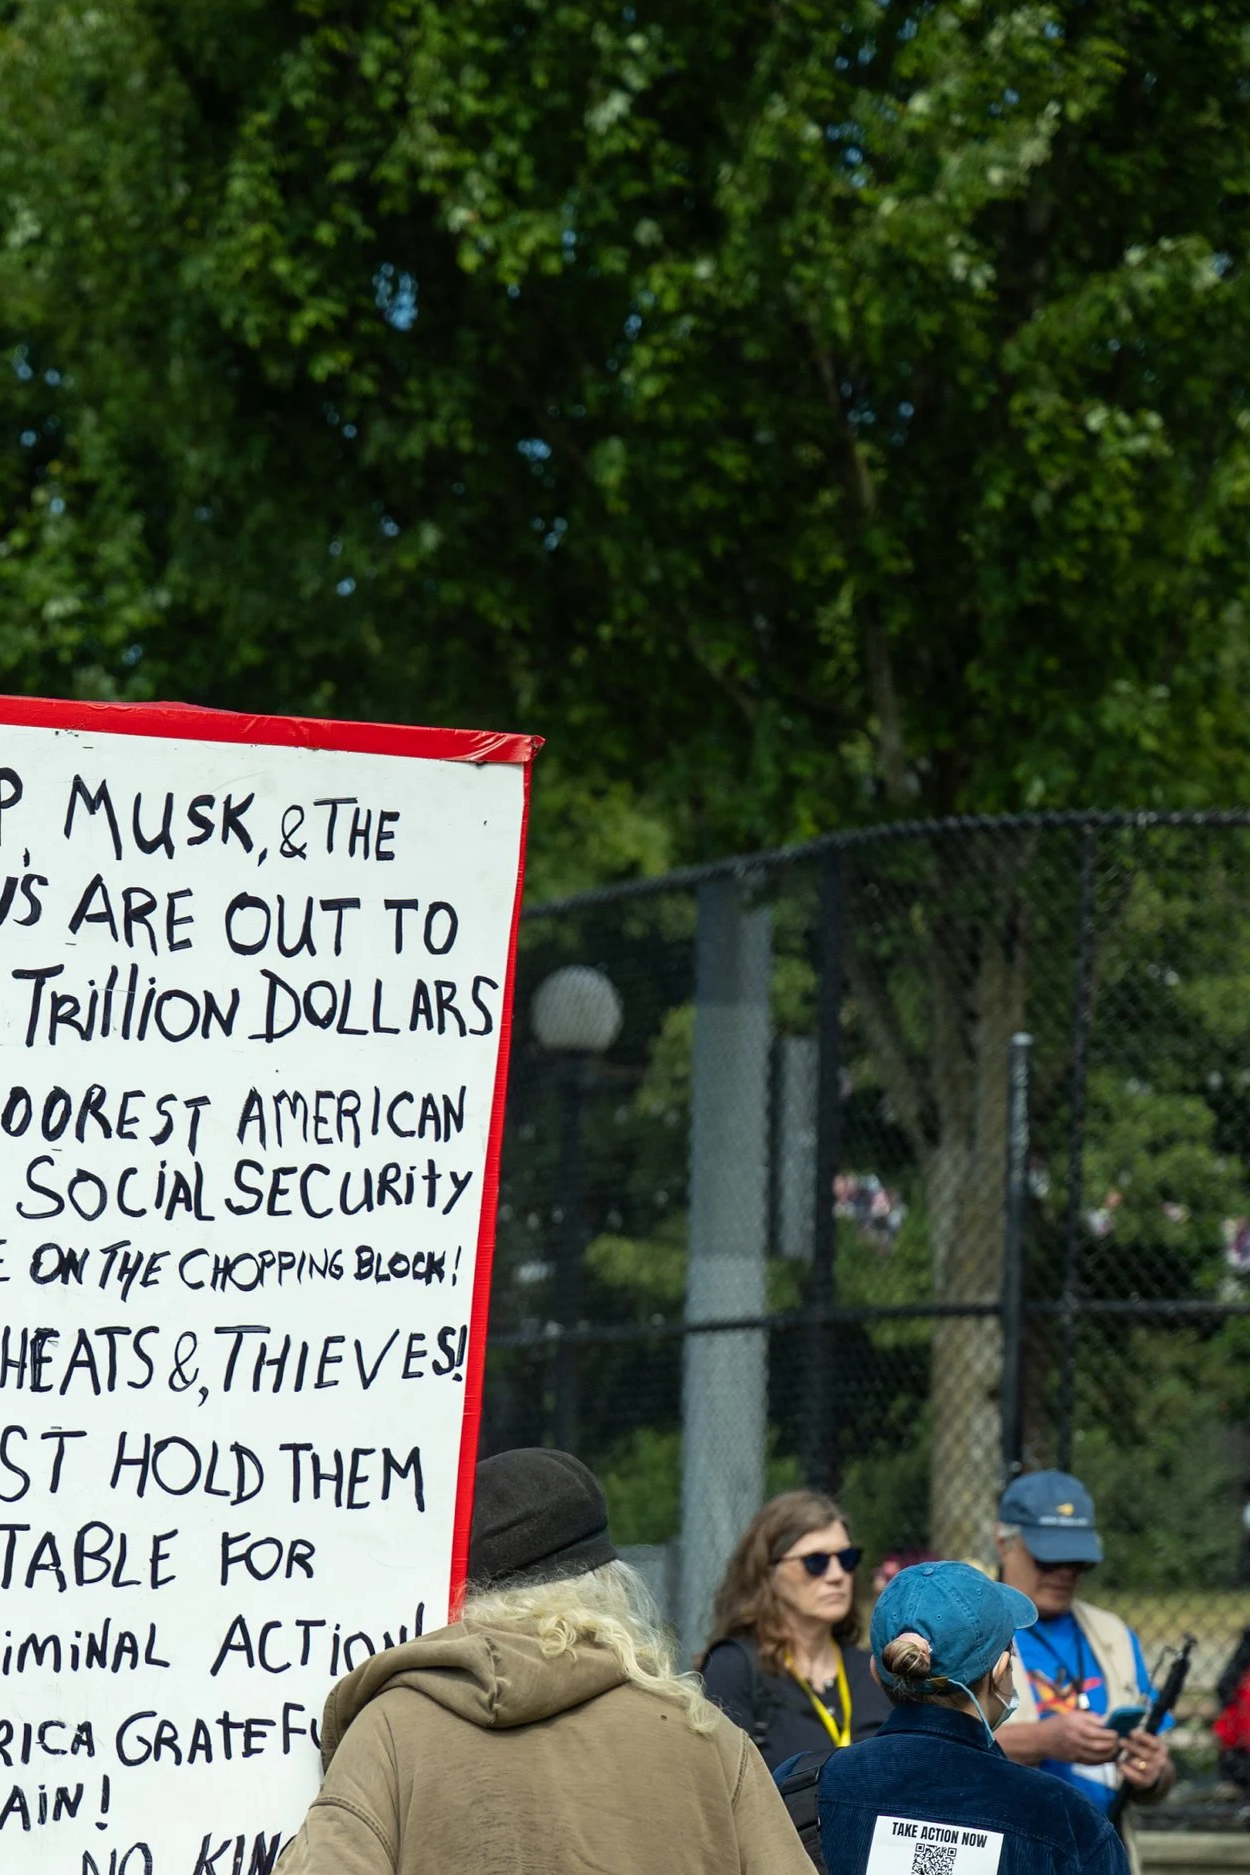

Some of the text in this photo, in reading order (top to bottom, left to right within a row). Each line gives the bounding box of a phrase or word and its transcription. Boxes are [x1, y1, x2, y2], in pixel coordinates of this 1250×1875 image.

[63, 774, 268, 867] MUSK,
[313, 797, 401, 862] THE
[68, 873, 195, 957] ARE
[224, 891, 361, 959] OUT
[383, 898, 459, 956] TO
[247, 968, 499, 1044] DOLLARS
[236, 1085, 467, 1151] AMERICAN
[29, 1242, 90, 1286] ON
[98, 1239, 171, 1303] THE
[178, 1247, 344, 1293] CHOPPING
[353, 1244, 463, 1287] BLOCK!
[214, 1324, 468, 1394] THIEVES!
[109, 1431, 265, 1507] HOLD
[278, 1442, 426, 1513] THEM
[220, 1531, 316, 1587] FOR
[892, 1822, 988, 1848] TAKE ACTION NOW
